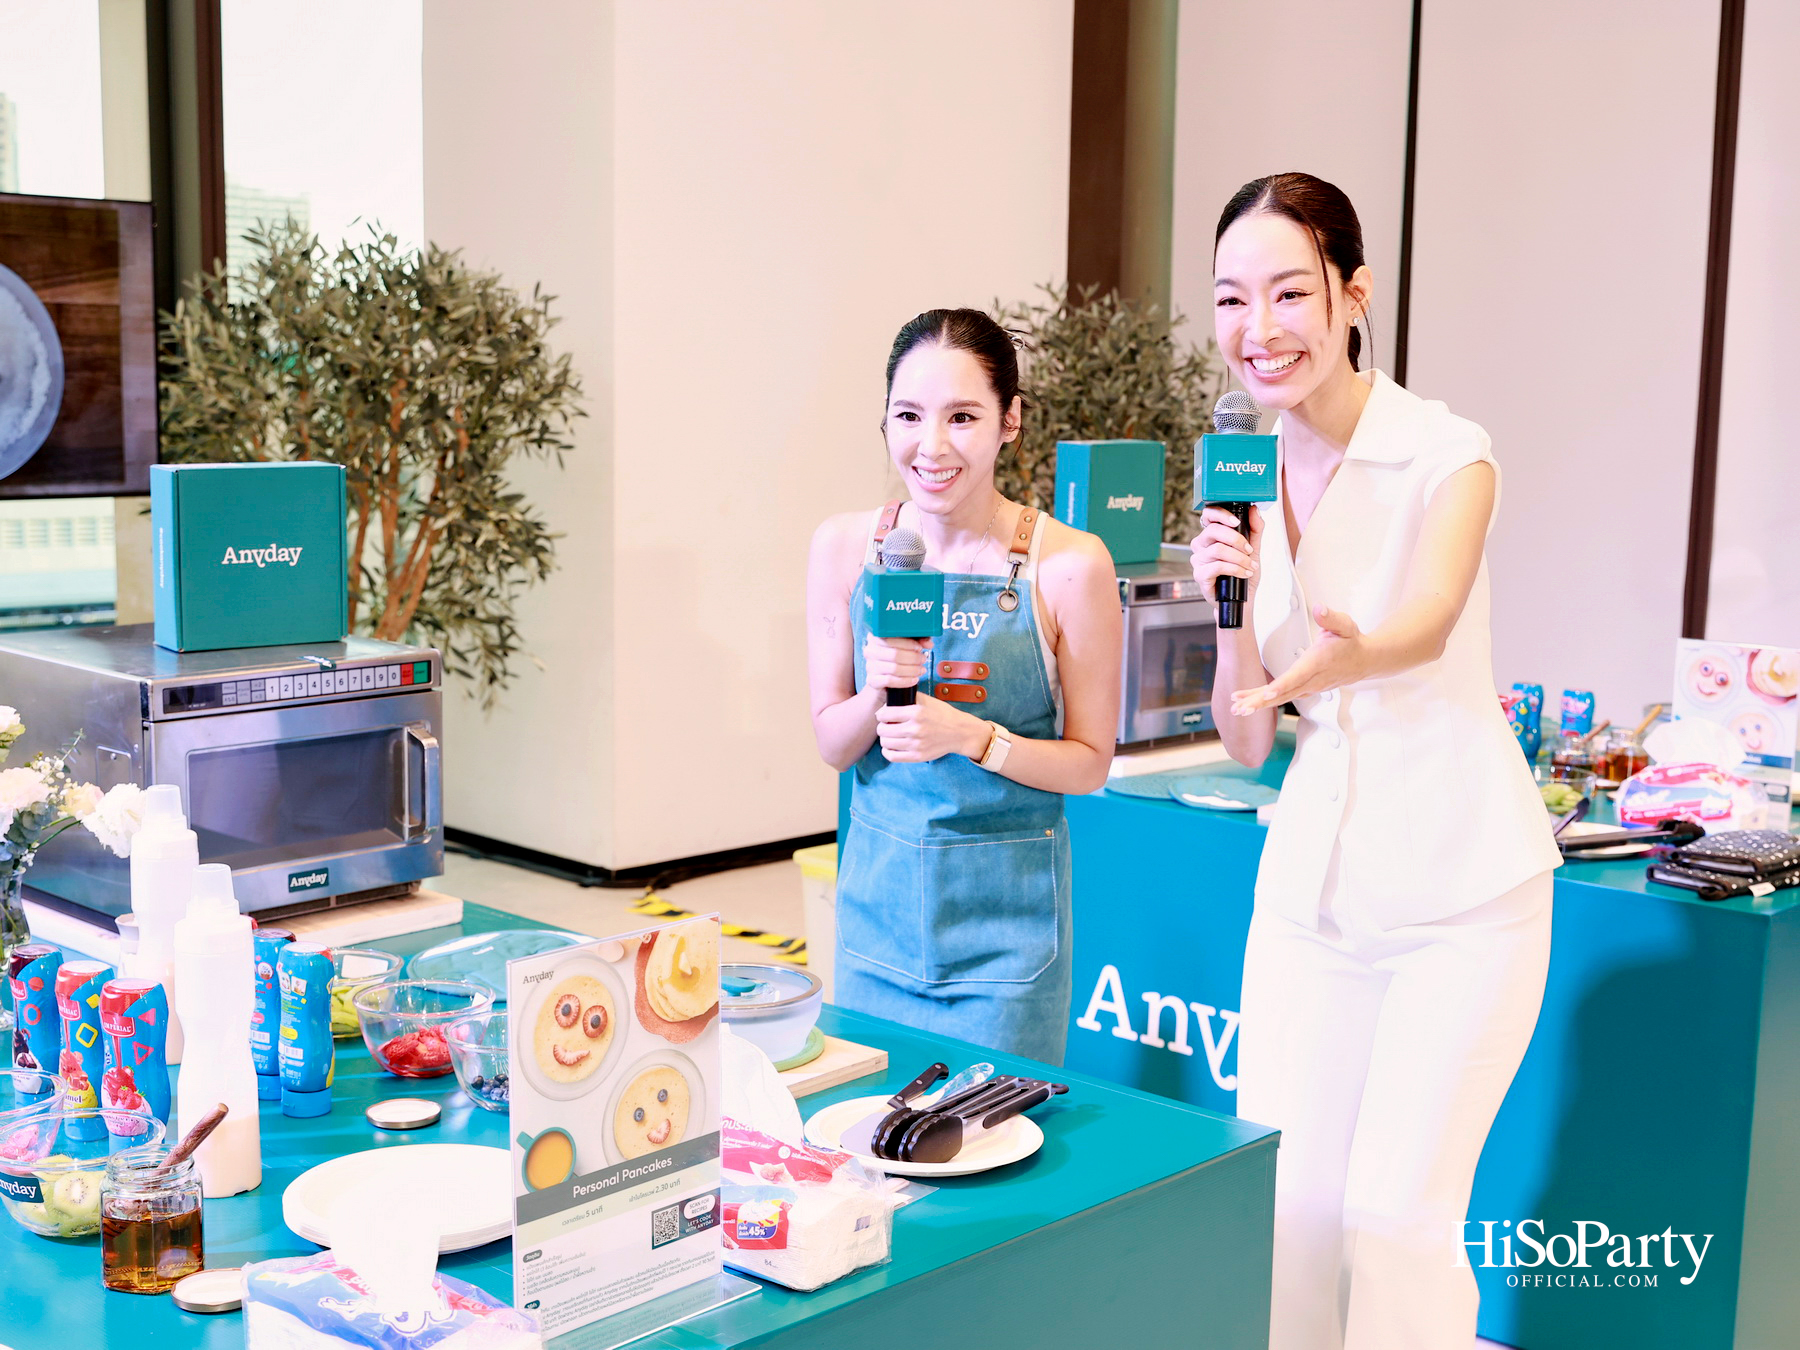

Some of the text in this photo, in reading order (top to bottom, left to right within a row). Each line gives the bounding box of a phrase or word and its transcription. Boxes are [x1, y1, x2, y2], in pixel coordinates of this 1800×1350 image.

[1214, 460, 1267, 475] Anyday
[1106, 493, 1144, 511] Anyday
[221, 543, 303, 568] Anyday
[886, 598, 934, 613] Anyday
[290, 872, 327, 887] Anyday
[522, 970, 554, 984] Anyday
[572, 1157, 672, 1198] Personal Pancakes
[0, 1179, 37, 1199] nyday
[655, 1182, 669, 1194] 2.30
[669, 1177, 681, 1188] นาที
[585, 1210, 590, 1218] 5
[591, 1204, 603, 1216] นาที
[689, 1201, 701, 1209] SCAN
[692, 1205, 708, 1214] RECIPES
[697, 1219, 714, 1229] ANYDAY
[699, 1214, 711, 1223] COOK
